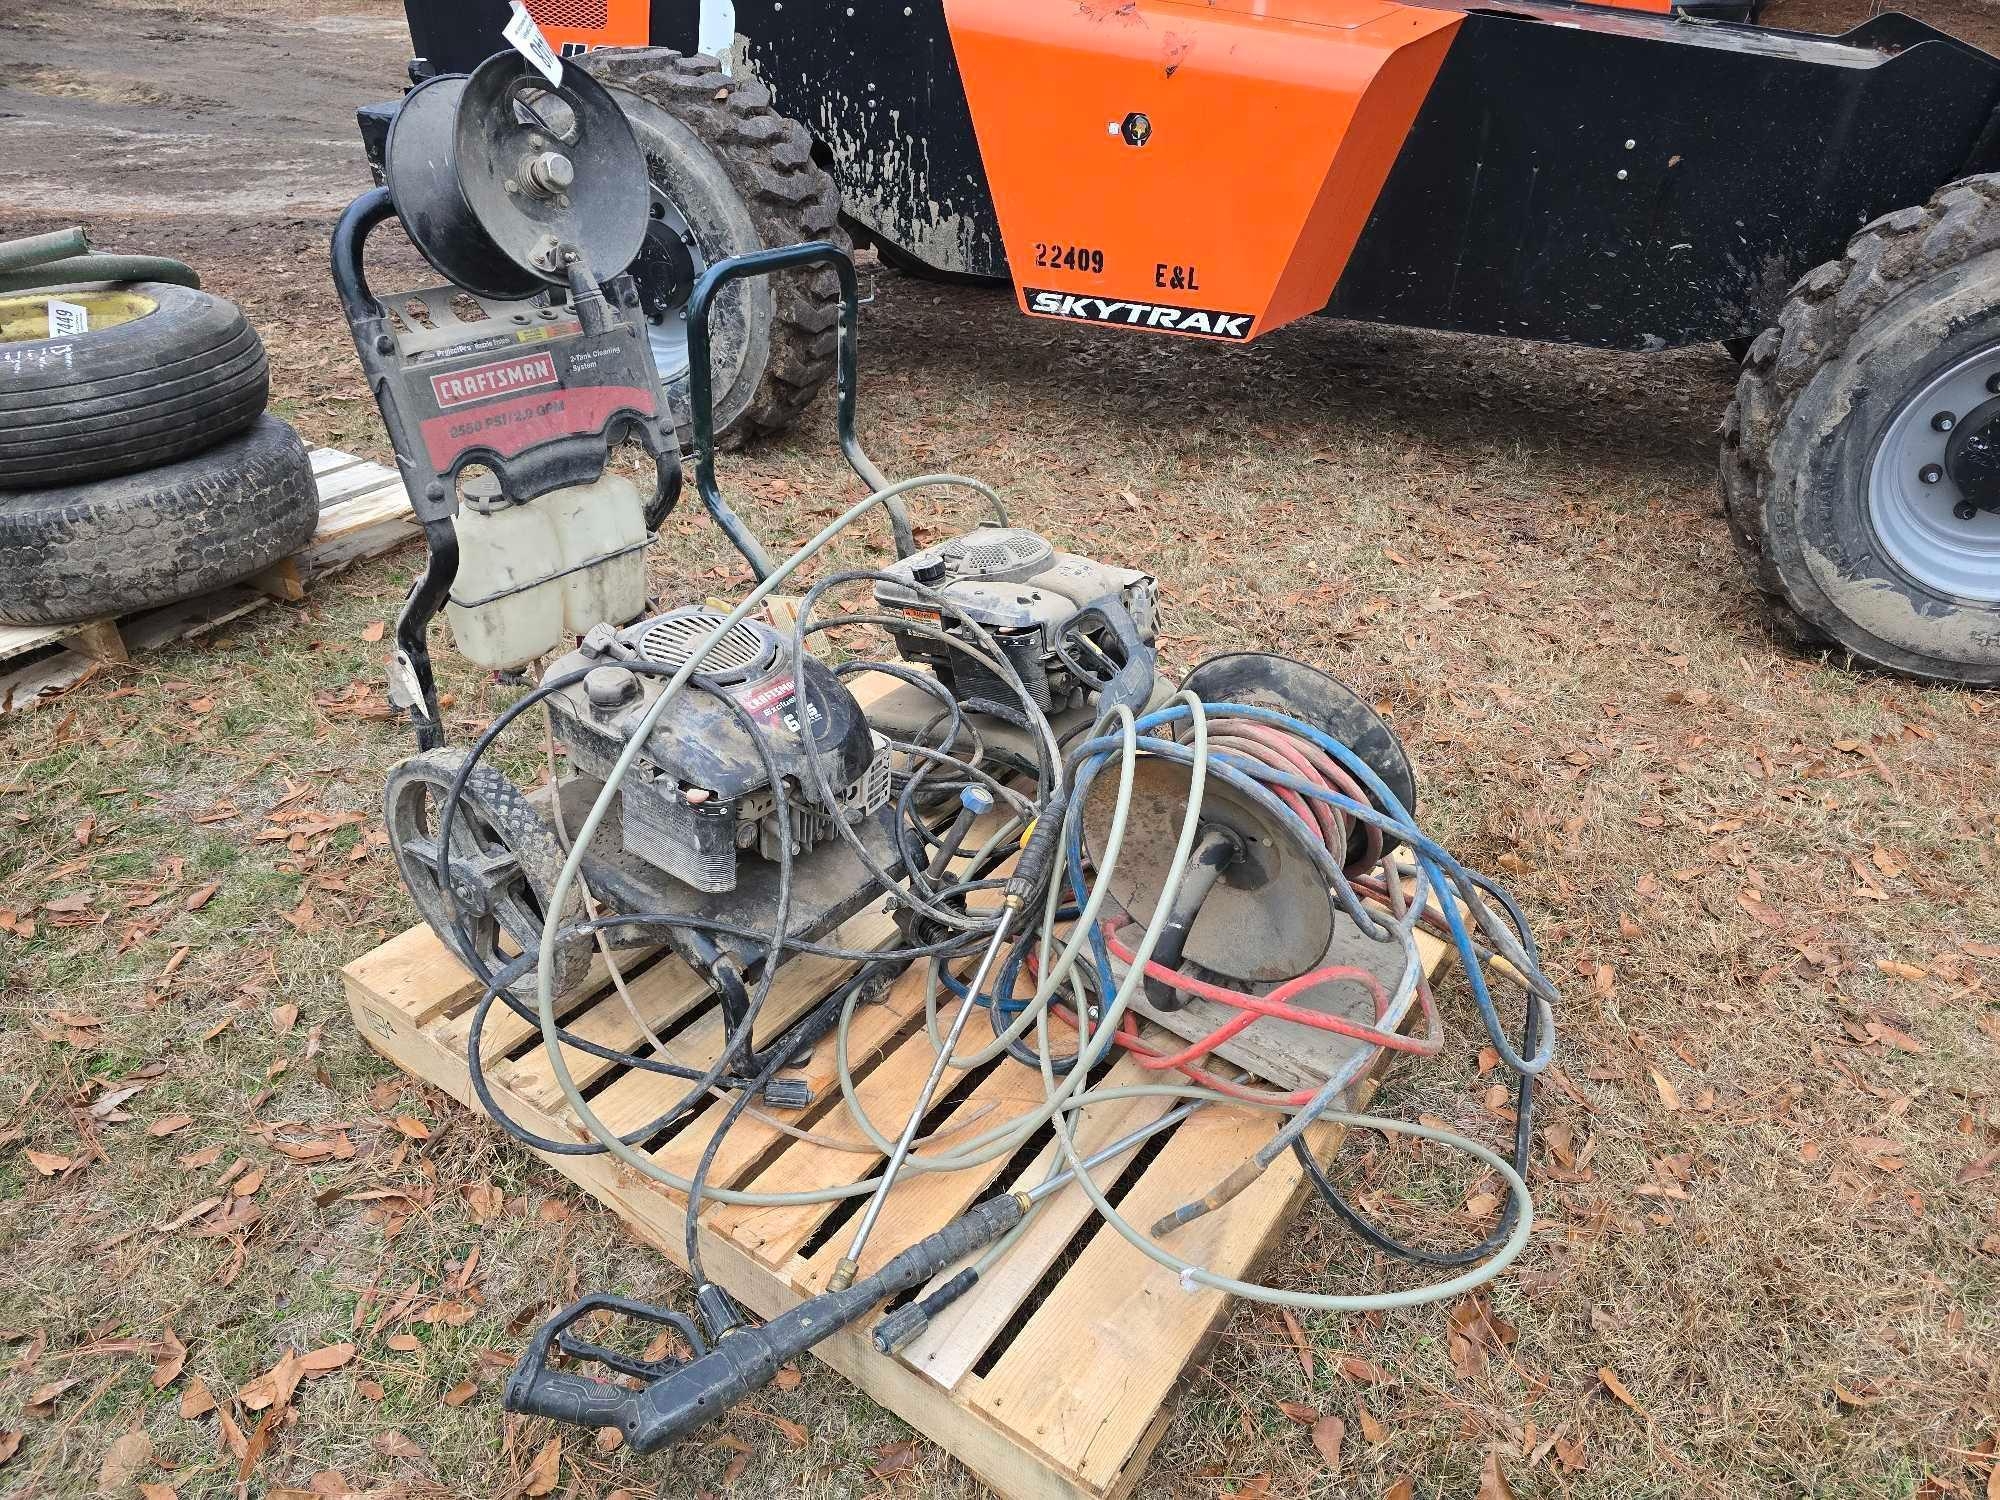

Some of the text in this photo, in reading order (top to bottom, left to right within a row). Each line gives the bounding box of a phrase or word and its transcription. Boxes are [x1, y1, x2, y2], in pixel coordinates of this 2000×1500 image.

[1035, 243, 1199, 291] 22409 E&L
[56, 309, 73, 335] 7449
[1032, 292, 1250, 337] SKYTRAK
[592, 346, 621, 359] Cleaning
[572, 360, 597, 372] System
[440, 361, 550, 400] CRAFTSMAN
[536, 399, 565, 418] GPM
